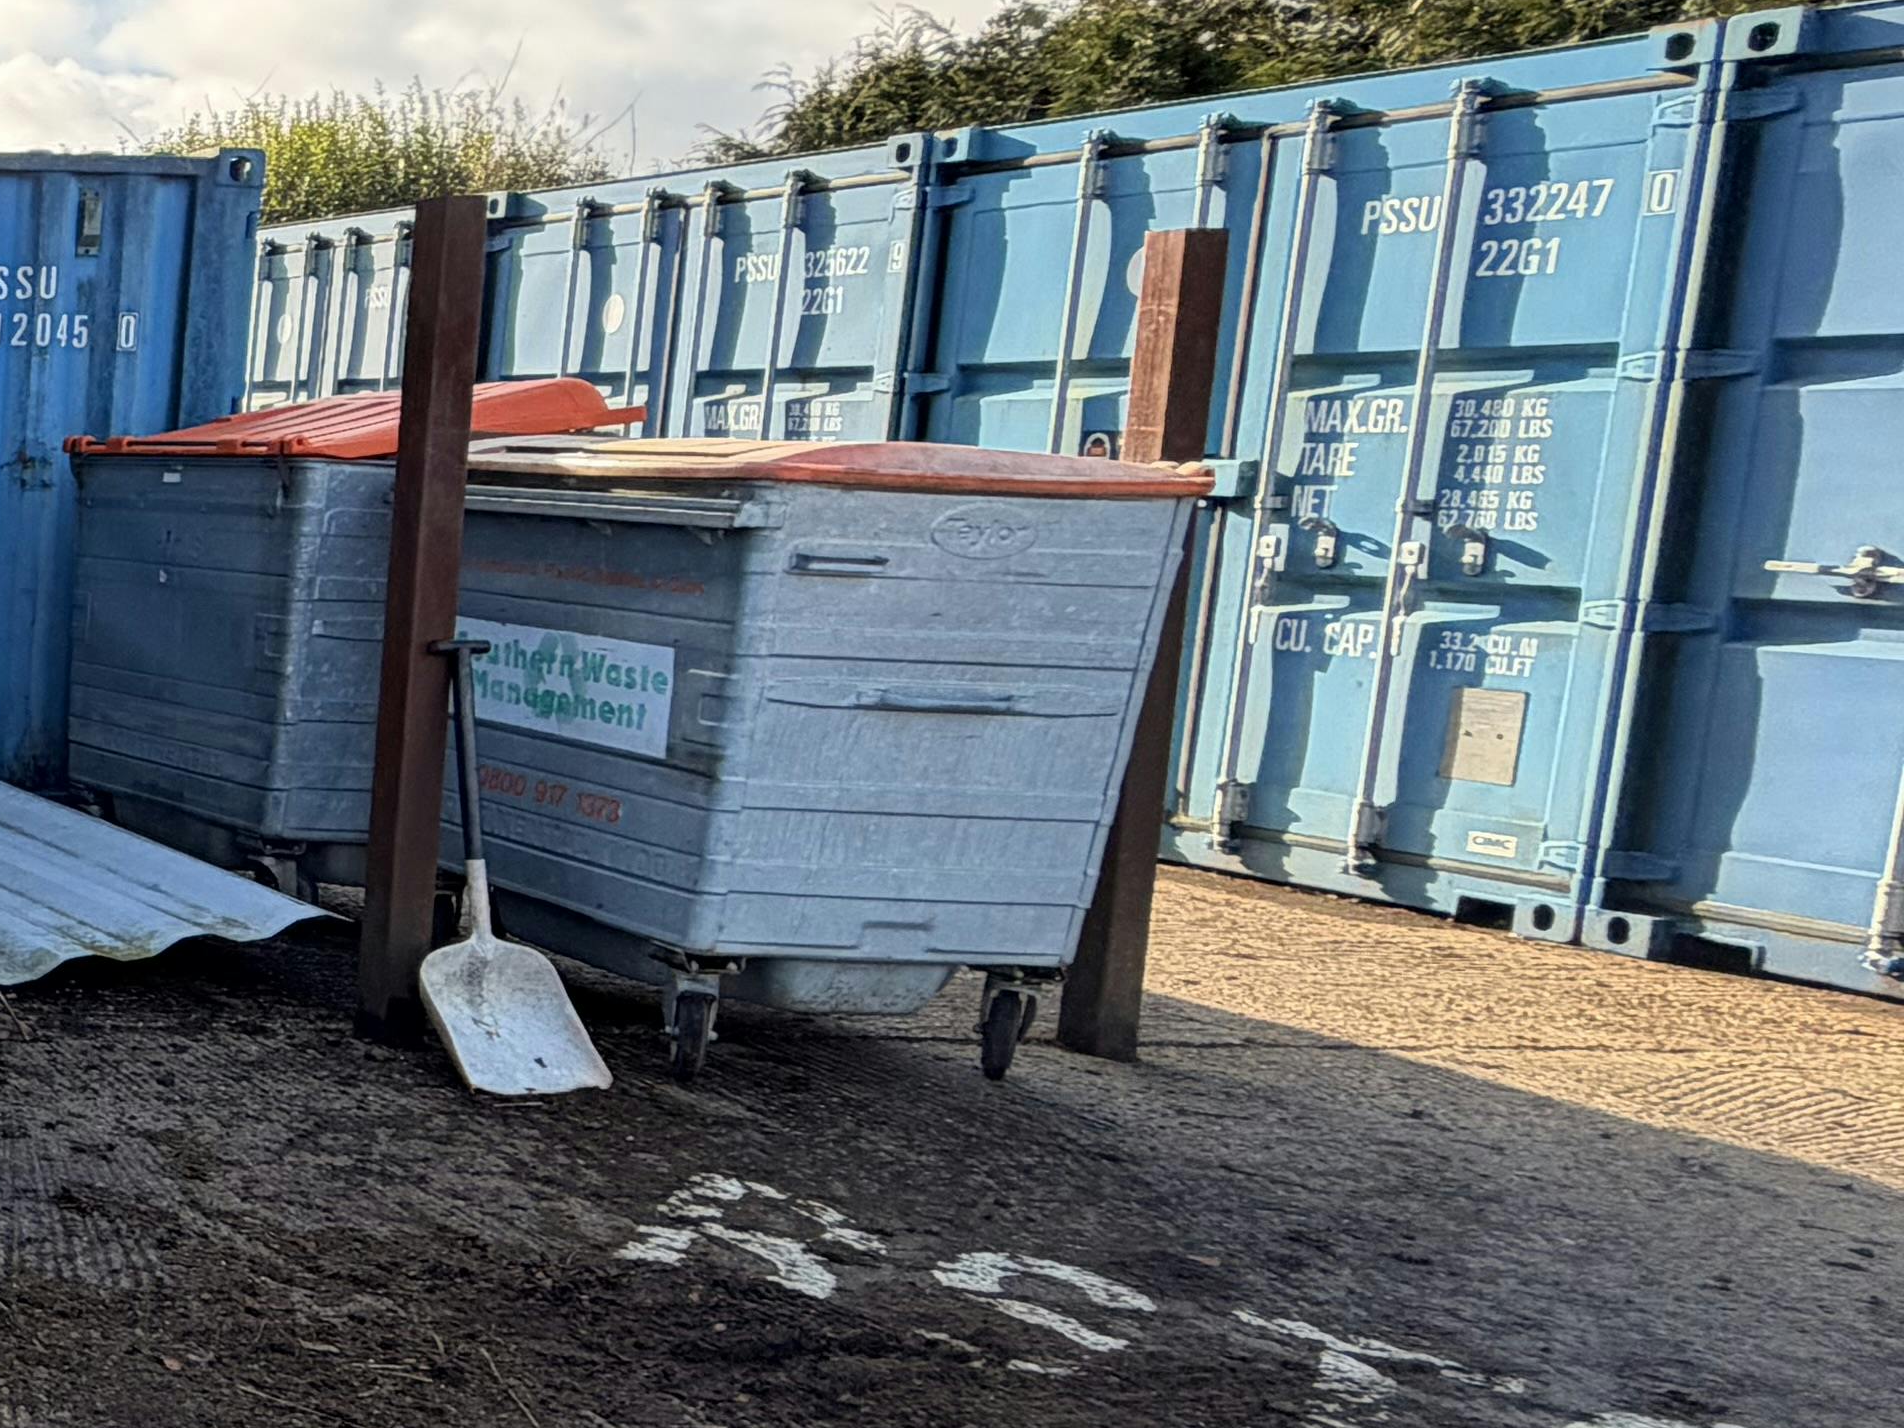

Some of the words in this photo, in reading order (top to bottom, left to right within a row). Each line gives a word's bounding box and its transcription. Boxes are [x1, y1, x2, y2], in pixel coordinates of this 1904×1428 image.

[1361, 195, 1442, 235] PSSU
[1483, 178, 1614, 226] 332247
[1649, 171, 1676, 214] 0
[805, 247, 870, 277] 325622
[1475, 237, 1561, 277] 22G1
[118, 313, 137, 349] 0
[1521, 398, 1549, 418] KG
[1518, 420, 1553, 438] LBS
[1301, 442, 1359, 477] TARE
[1514, 445, 1540, 463] KG
[1510, 465, 1546, 484] LBS
[1293, 484, 1339, 518] NET
[1506, 490, 1534, 509] KG
[1504, 511, 1538, 530] LBS
[1276, 618, 1311, 652] CU.
[1323, 622, 1377, 660] CAP.
[581, 651, 669, 695] Waste
[474, 669, 648, 731] Management
